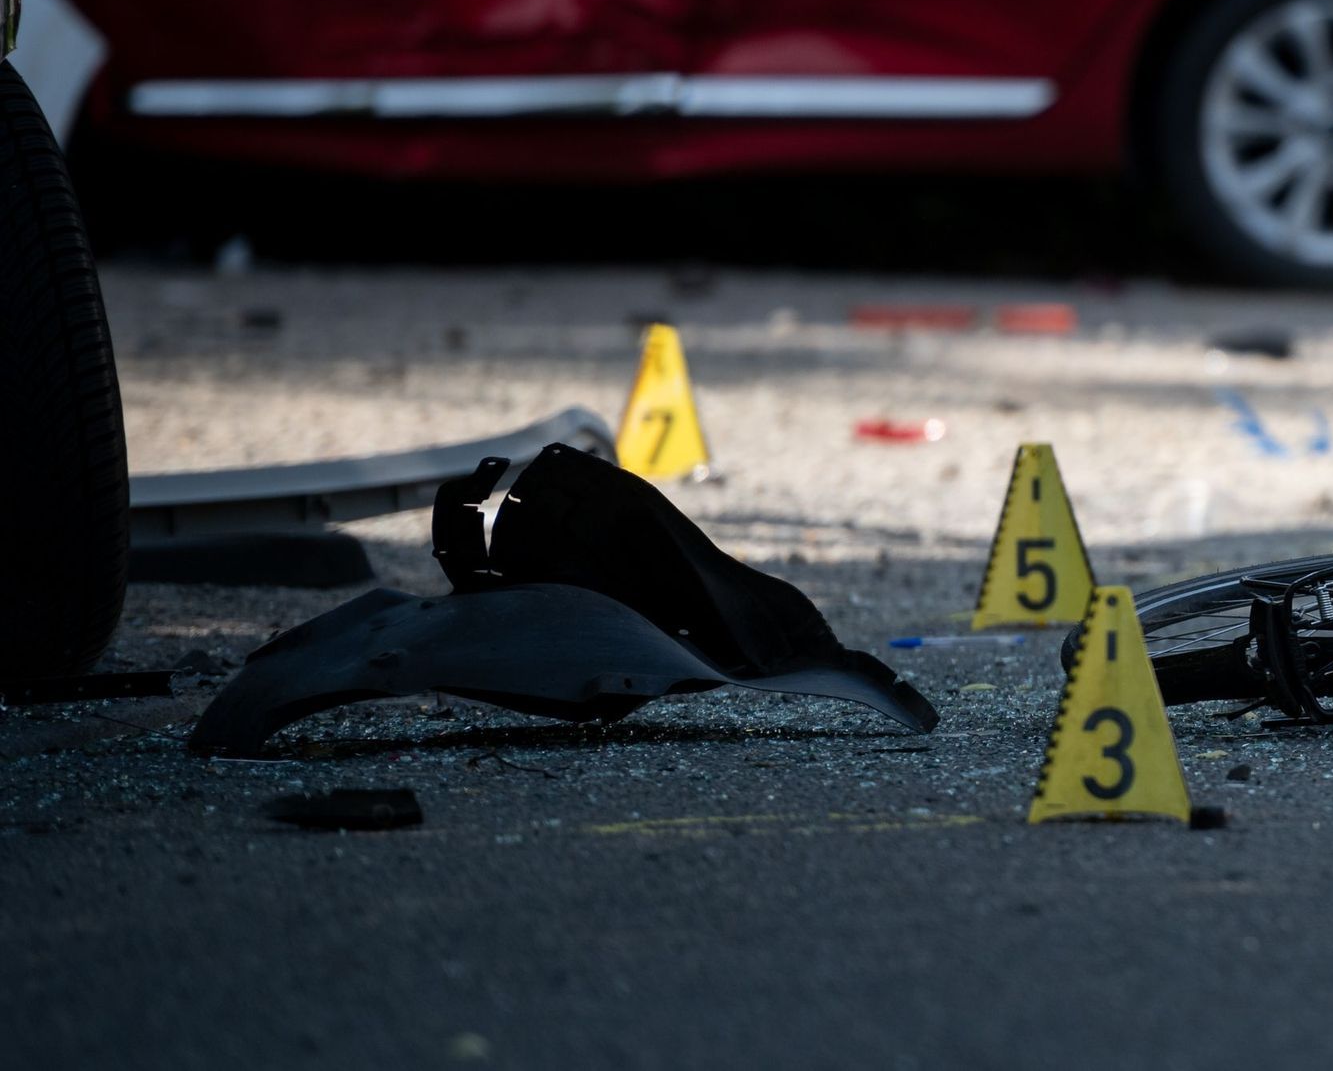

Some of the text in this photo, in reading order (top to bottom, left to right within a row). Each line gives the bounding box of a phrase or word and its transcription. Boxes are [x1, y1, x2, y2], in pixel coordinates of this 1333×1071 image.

[642, 407, 675, 466] 7
[1015, 537, 1057, 611] 5
[1082, 706, 1135, 800] 3
